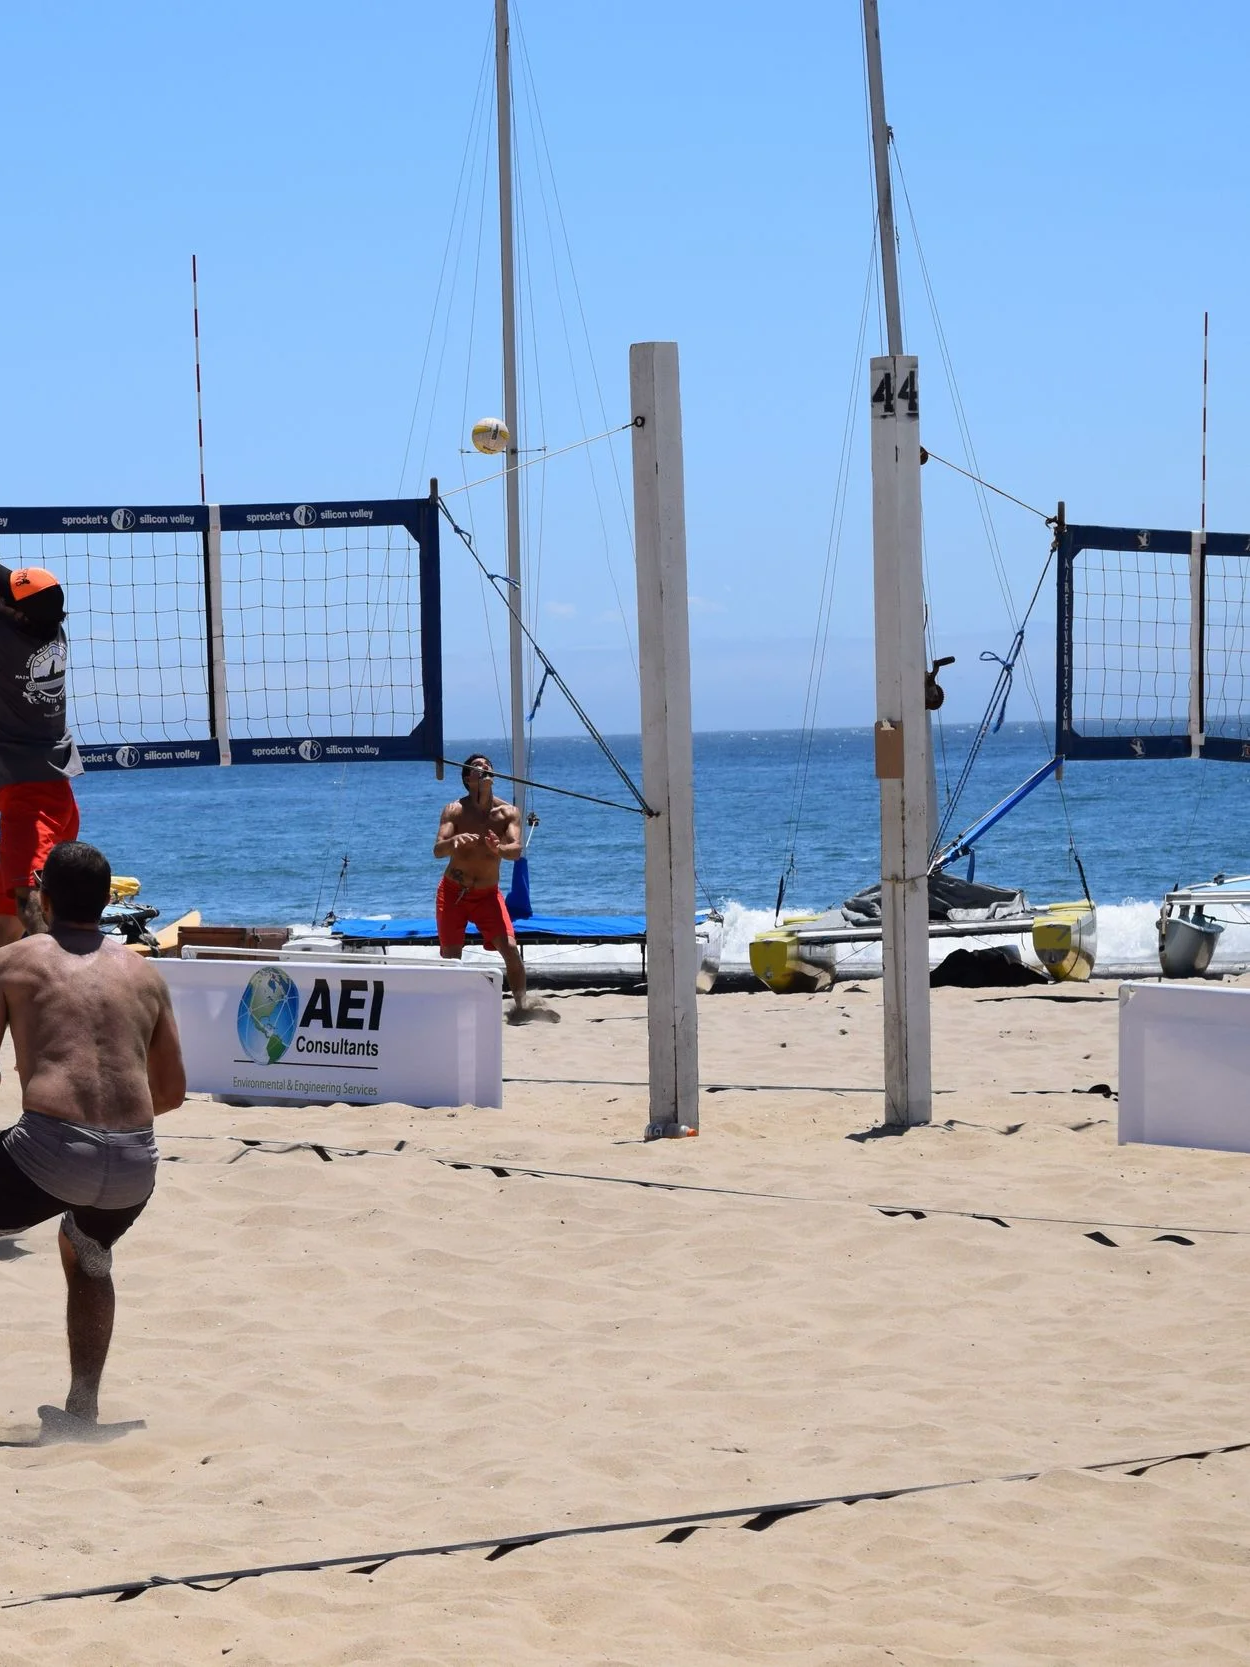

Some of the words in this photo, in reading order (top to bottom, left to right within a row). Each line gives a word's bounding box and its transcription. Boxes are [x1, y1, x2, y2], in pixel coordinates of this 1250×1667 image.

[62, 514, 109, 527] sprocket's
[139, 514, 168, 524] silicon
[169, 514, 195, 525] volley
[246, 511, 291, 524] sprocket's
[320, 509, 348, 520] silicon
[349, 508, 374, 520] volley
[82, 753, 113, 763] ocket's
[144, 750, 173, 761] silicon
[175, 749, 200, 760] volley
[252, 746, 296, 757] sprocket's
[325, 745, 353, 754] silicon
[355, 745, 379, 756] volley
[299, 978, 385, 1031] AEI
[296, 1035, 379, 1057] Consultants
[233, 1076, 286, 1091] Environmental
[287, 1080, 293, 1091] &
[294, 1080, 342, 1096] Engineering
[343, 1082, 378, 1096] Services
